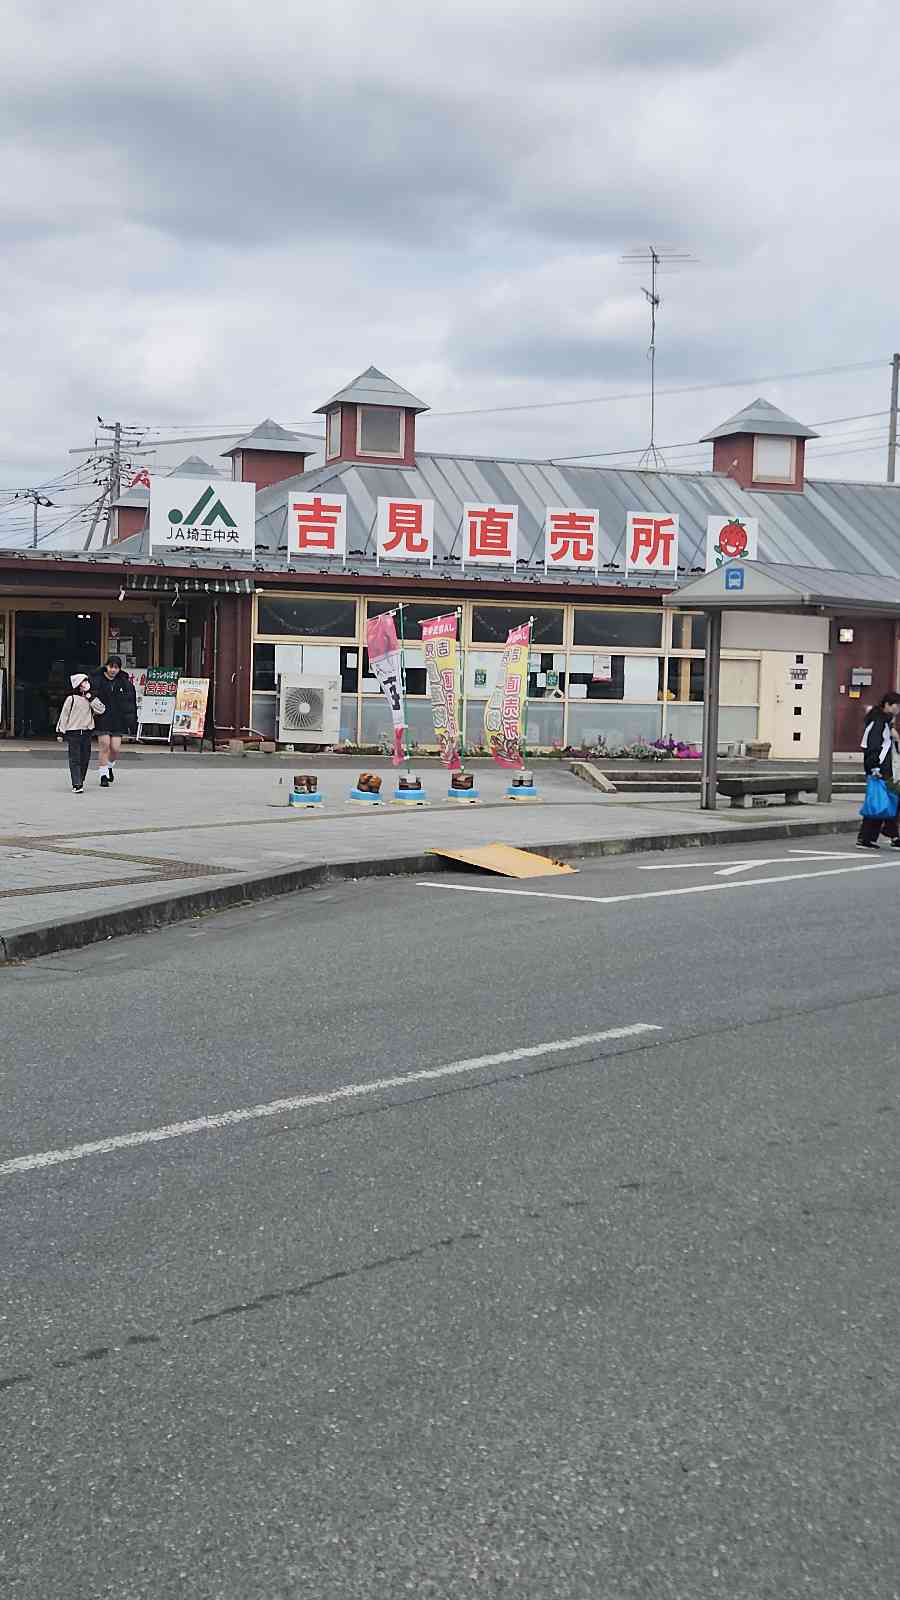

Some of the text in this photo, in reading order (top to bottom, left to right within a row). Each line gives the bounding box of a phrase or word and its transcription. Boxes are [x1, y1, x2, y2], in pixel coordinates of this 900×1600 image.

[166, 527, 240, 543] JA埼玉中央
[293, 497, 675, 566] 吉見直売所
[145, 680, 177, 695] 営業中
